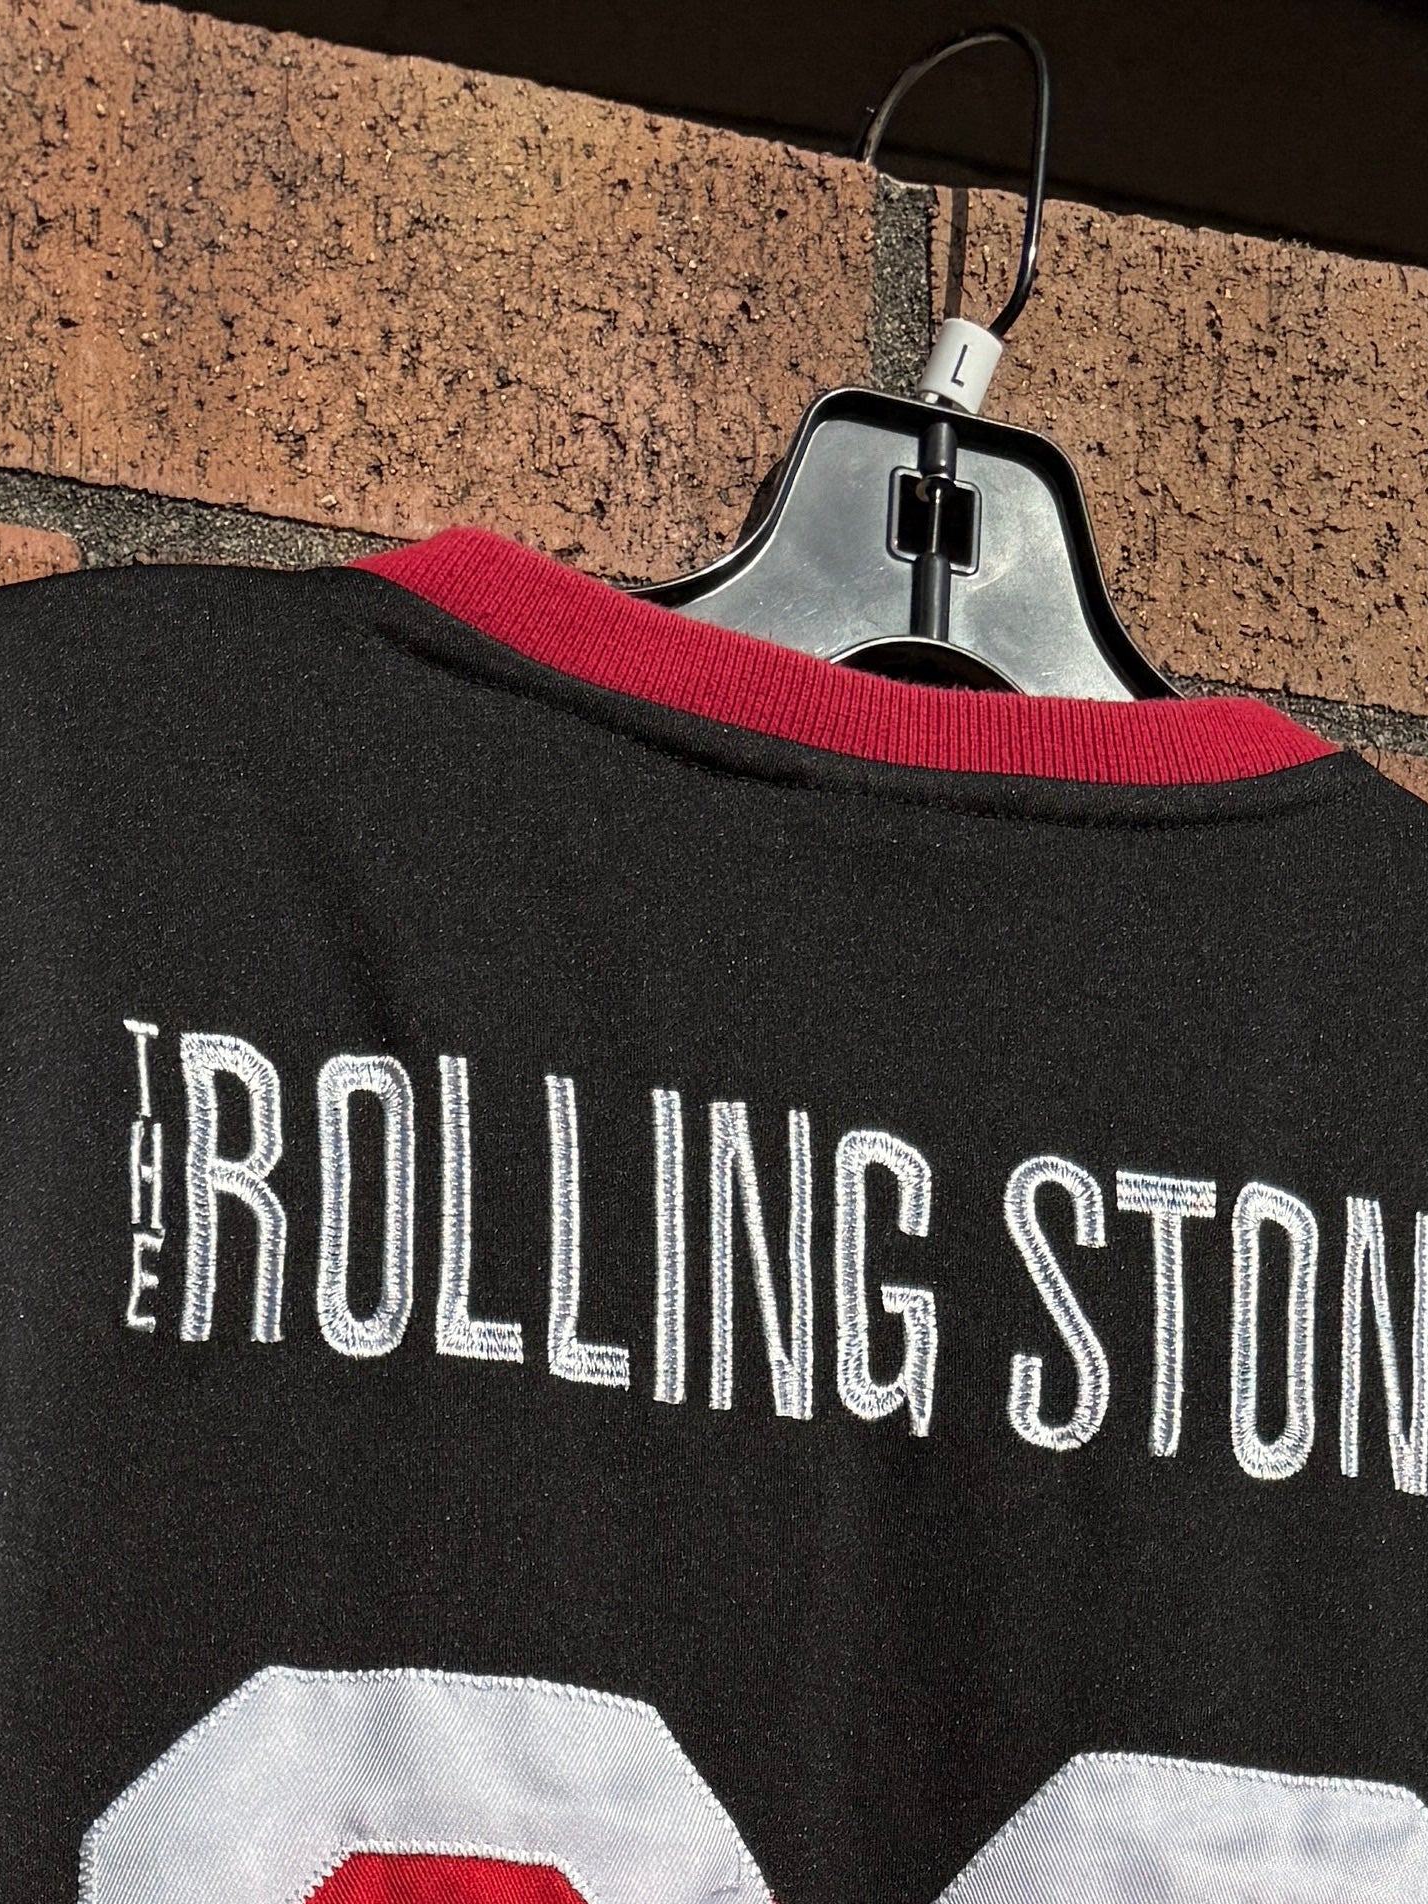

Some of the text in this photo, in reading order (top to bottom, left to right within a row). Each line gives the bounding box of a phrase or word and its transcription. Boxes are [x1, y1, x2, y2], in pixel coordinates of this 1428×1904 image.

[950, 344, 968, 388] L
[122, 1018, 166, 1334] THE
[179, 1031, 939, 1439] ROLLING
